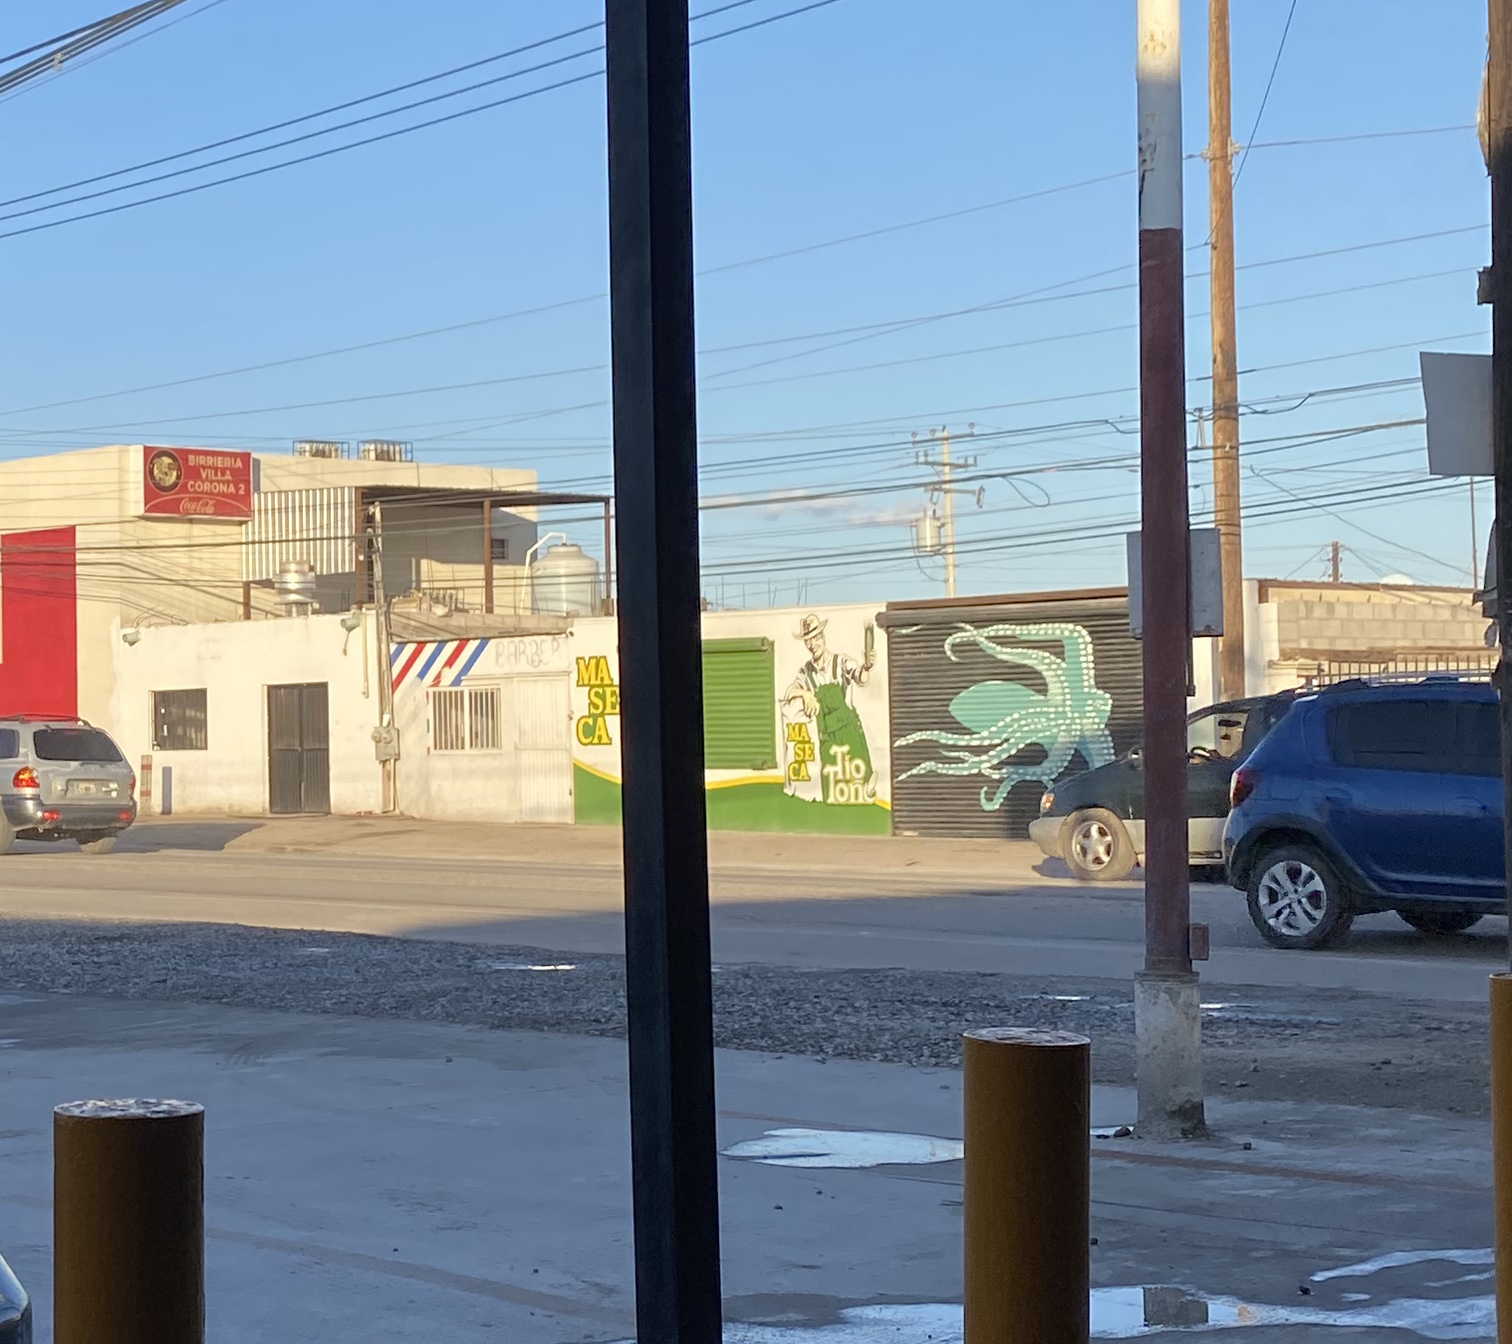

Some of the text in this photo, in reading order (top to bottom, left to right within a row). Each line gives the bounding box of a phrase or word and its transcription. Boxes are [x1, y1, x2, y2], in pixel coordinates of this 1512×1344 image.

[188, 455, 243, 469] BIRRIERIA
[200, 468, 232, 481] VILLA
[187, 481, 246, 495] CORONA 2
[495, 639, 561, 668] BARBER
